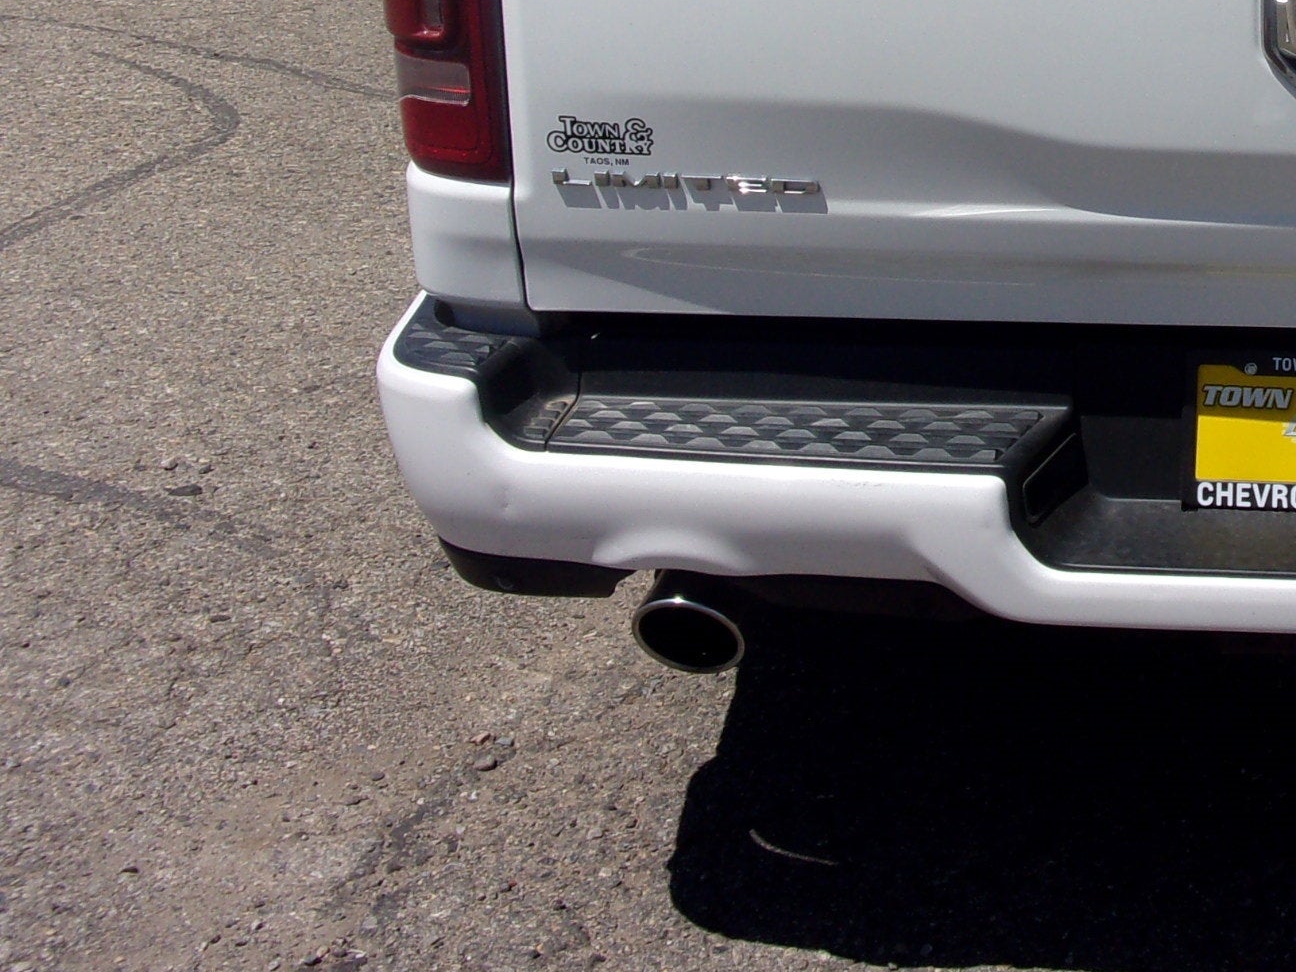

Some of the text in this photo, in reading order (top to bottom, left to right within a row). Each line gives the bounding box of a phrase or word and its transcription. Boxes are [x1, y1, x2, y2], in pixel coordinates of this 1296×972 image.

[623, 117, 654, 143] &
[615, 157, 630, 166] NM
[552, 167, 822, 196] LIMITED
[1202, 385, 1292, 409] TOWN
